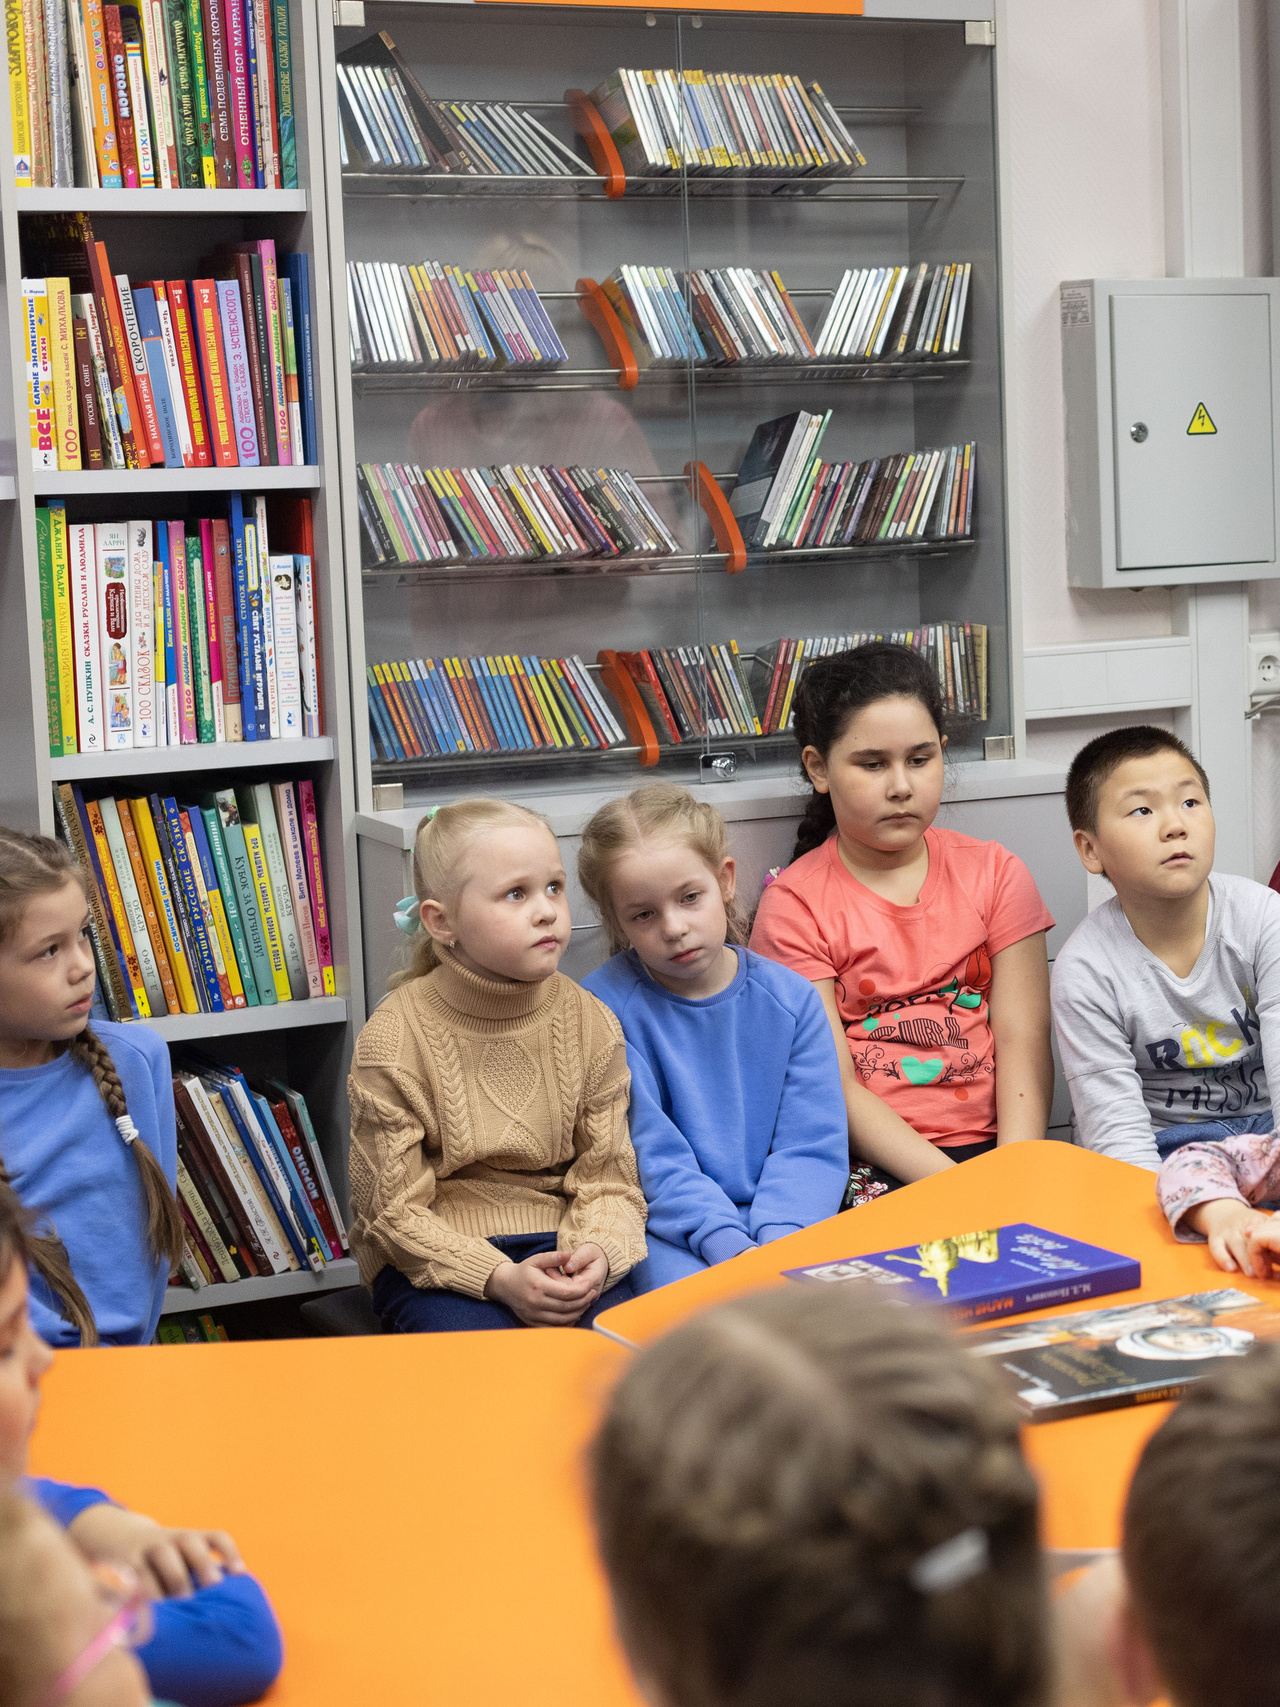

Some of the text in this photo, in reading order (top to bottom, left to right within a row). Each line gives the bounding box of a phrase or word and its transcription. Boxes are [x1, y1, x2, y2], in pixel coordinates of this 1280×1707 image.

[91, 18, 99, 29] А.
[93, 32, 104, 70] БАРТО
[235, 50, 245, 73] БОГ
[277, 6, 291, 116] ВОЛШЕБНЫЕ СКАЗКИ ИТАЛИИ
[114, 55, 130, 117] МОРОЗКО
[133, 59, 141, 92] праздникам
[174, 21, 195, 146] МАЛАХИТОВАЯ ШКАТУЛКА
[192, 31, 208, 118] Медной горы хозяйка
[213, 39, 226, 108] ПОДЗЕМНЫХ
[218, 111, 229, 141] СЕМЬ
[236, 77, 250, 145] ОГНЕННЫЙ
[139, 129, 151, 171] СТИХИ
[57, 290, 67, 341] МИХАЛКОВА
[203, 294, 209, 303] 2
[120, 287, 145, 372] СКОРОЧТЕНИЕ
[225, 289, 240, 349] УСПЕНСКОГО
[40, 338, 48, 372] СТИХИ
[164, 328, 176, 367] мужества
[234, 352, 242, 361] Э.
[268, 278, 287, 430] 100 ЛЮБИМЫХ МАЛЕНЬКИХ СКАЗОК
[27, 298, 52, 450] ВСЕ САМЫЕ ЗНАМЕНИТЫЕ
[203, 308, 229, 445] ПОЛНАЯ ХРЕСТОМАТИЯ ДЛЯ НАЧАЛЬНОЙ ШКОЛЫ
[82, 364, 95, 425] РУССКИЙ СОНЕТ
[140, 378, 158, 439] НАТАЛЬЯ ГРЭЙС
[64, 429, 77, 460] 100
[161, 397, 176, 458] БОРОДИНСКОЕ ПОЛЕ
[241, 427, 256, 459] 100
[54, 519, 64, 559] ДЖАННИ
[78, 528, 86, 572] ЛЮДМИЛА
[141, 549, 149, 570] САДУ
[238, 569, 244, 581] НА
[57, 564, 65, 597] РОДАРИ
[142, 573, 151, 611] ДЕТСКОМ
[81, 584, 89, 618] РУСЛАН
[238, 584, 247, 620] СТОРОЖ
[59, 602, 68, 645] БОЛЬШАЯ
[62, 648, 70, 678] КНИГА
[223, 615, 238, 697] ПРИКЛЮЧЕНИЯ
[253, 634, 261, 671] УСТАЛЫЕ
[46, 618, 61, 746] РАССКАЗЫ И СКАЗКИ
[85, 661, 93, 702] ПУШКИН
[138, 650, 152, 720] 100 СКАЗОК
[256, 673, 264, 710] ИГРУШКИ
[87, 716, 94, 724] А.
[285, 789, 294, 809] дома
[251, 838, 259, 849] ПРО
[289, 818, 298, 842] школе
[252, 851, 263, 880] МАШИНЫ,
[294, 851, 303, 880] Малеев
[308, 821, 326, 927] Лучшие сказочники мира
[154, 860, 182, 953] КОСМИЧЕСКИЕ ИСТОРИИ
[171, 818, 213, 972] ЛУЧШИЕ РУССКИЕ СКАЗКИ
[298, 882, 306, 899] Витя
[132, 900, 146, 931] КРУЗО
[265, 917, 275, 942] КОРАБЛИ
[302, 905, 311, 929] Носов
[271, 950, 282, 972] ПОЕЗДА
[305, 932, 316, 965] Николай
[1145, 1008, 1260, 1069] ROCK
[1165, 1064, 1266, 1113] MUSIC
[292, 1146, 319, 1199] МОРОЗКО
